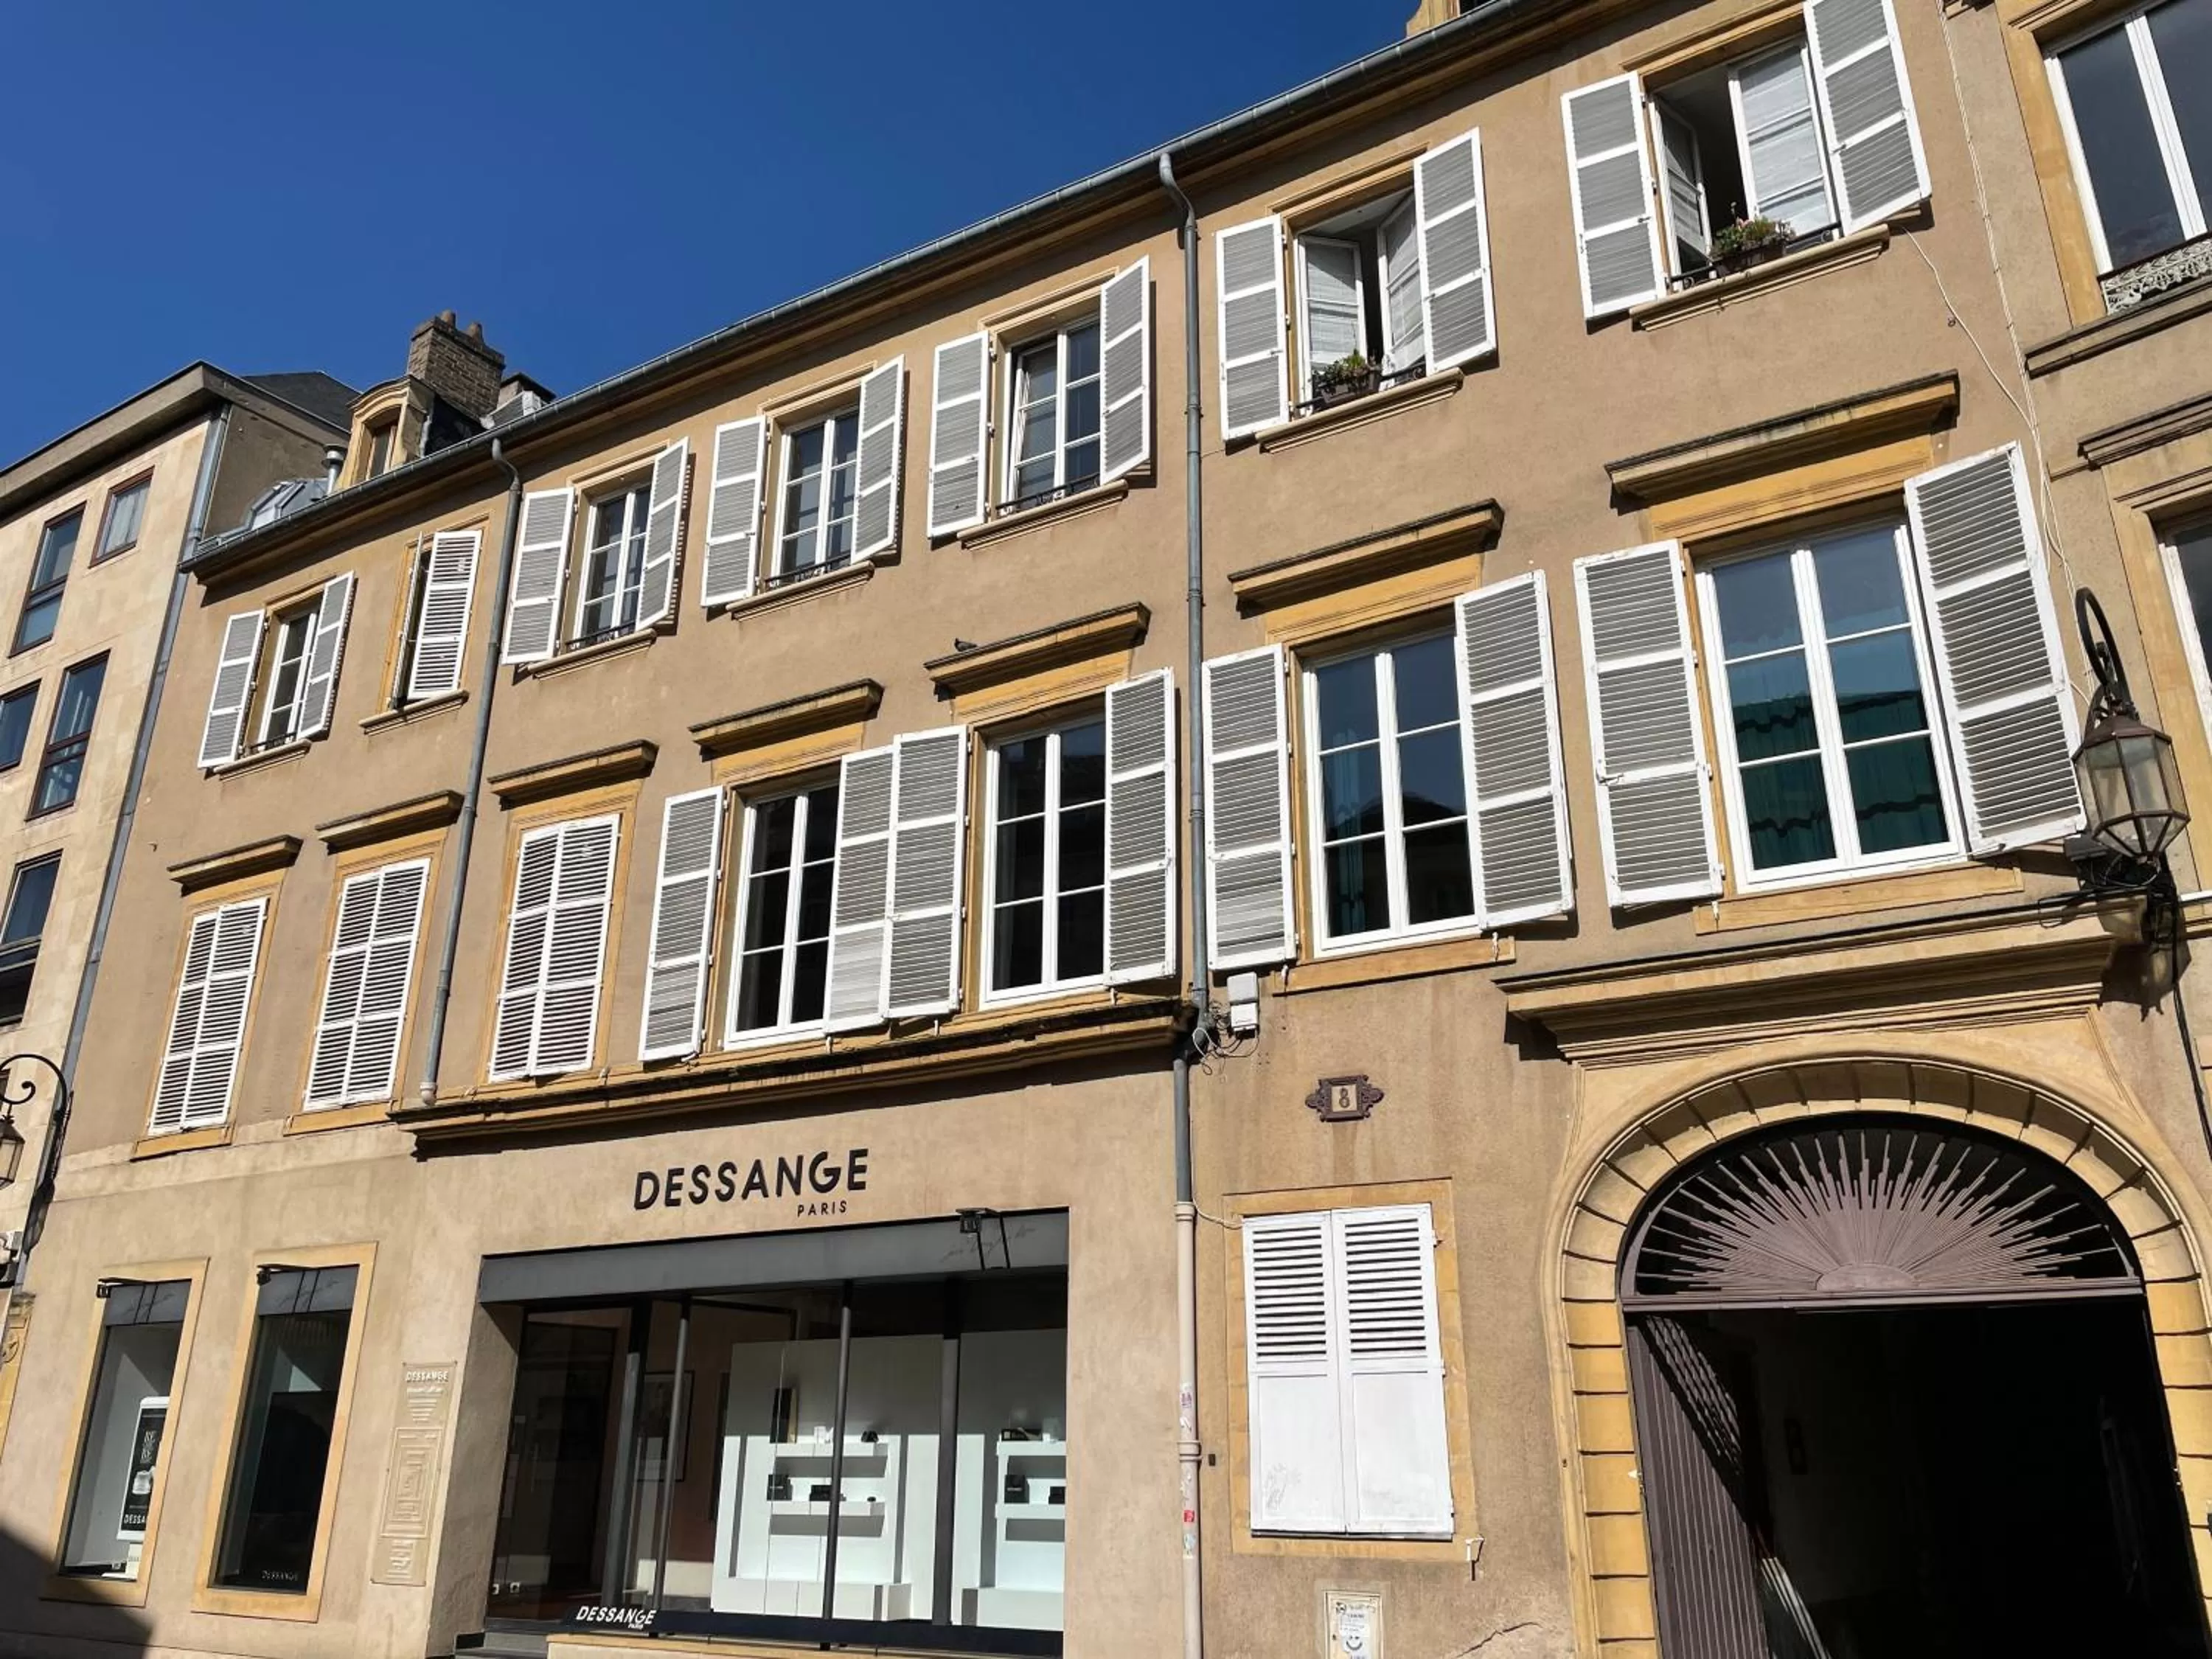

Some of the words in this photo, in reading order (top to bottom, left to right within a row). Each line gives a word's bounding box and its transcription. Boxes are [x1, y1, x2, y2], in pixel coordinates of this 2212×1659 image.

[1339, 1088, 1350, 1108] 8
[633, 1148, 869, 1211] DESSANGE
[797, 1200, 847, 1217] PARIS
[406, 1371, 449, 1382] DESSANGE
[576, 1606, 657, 1624] DESSANGE
